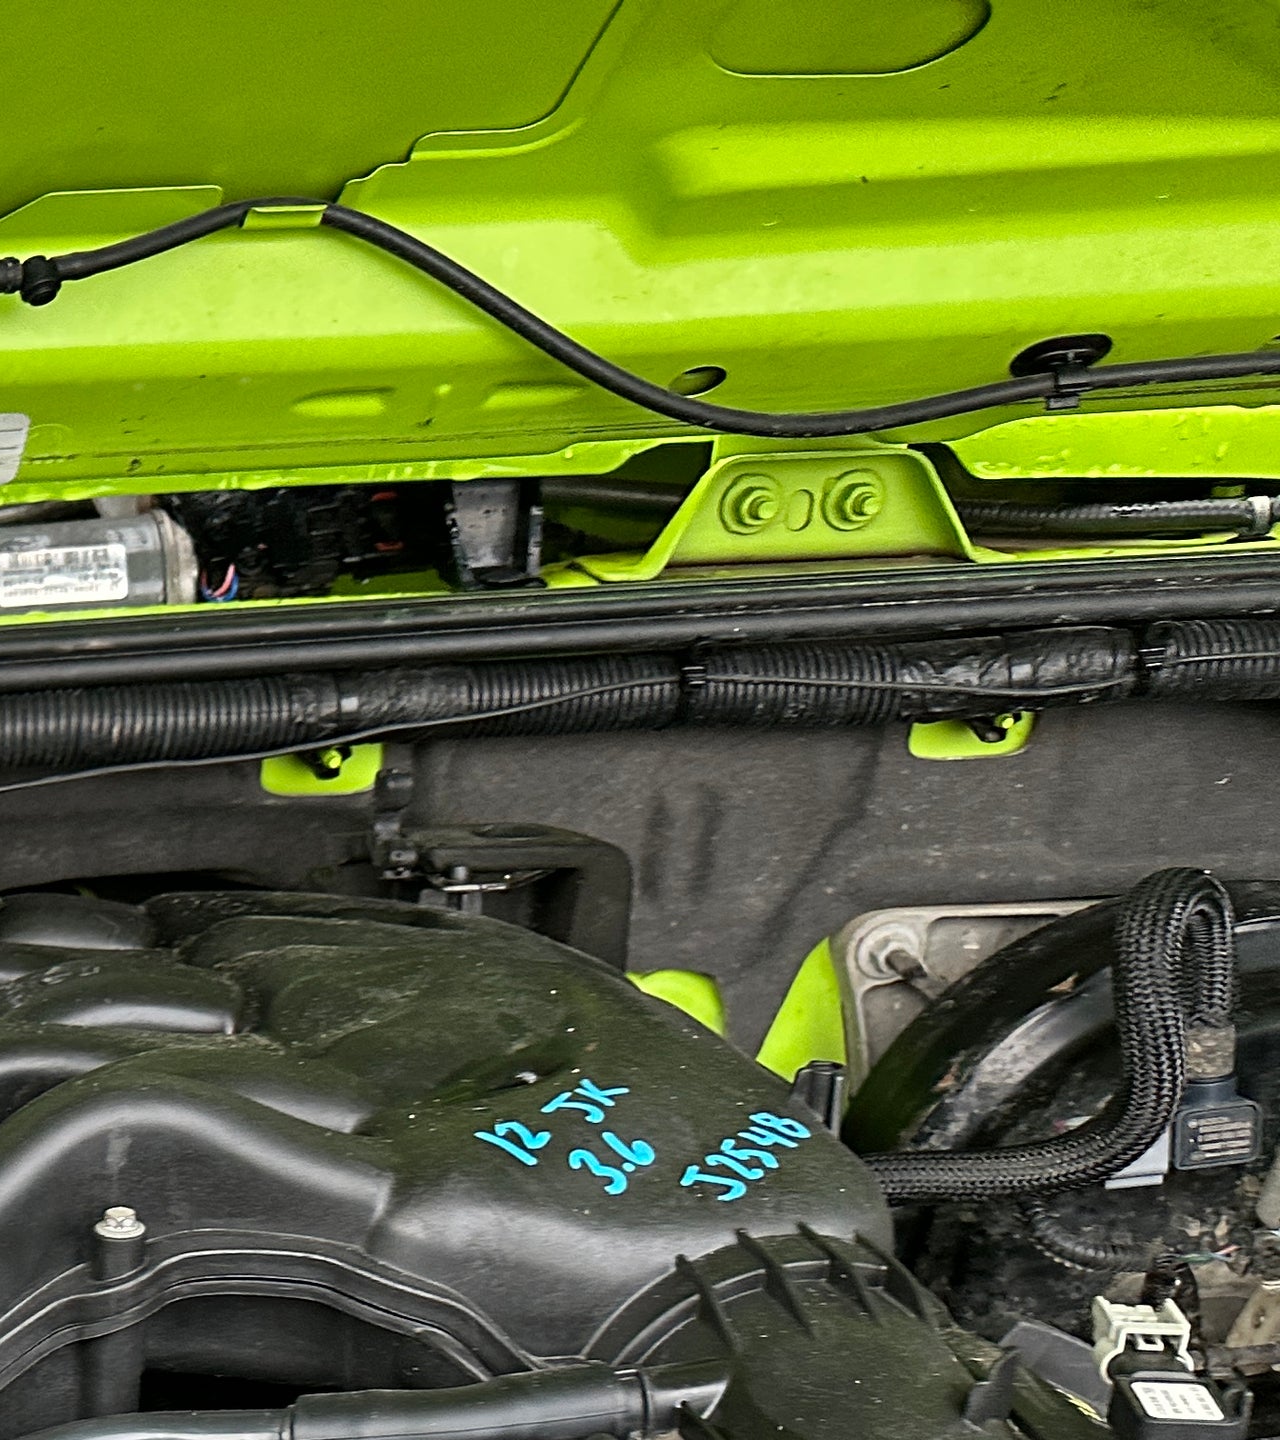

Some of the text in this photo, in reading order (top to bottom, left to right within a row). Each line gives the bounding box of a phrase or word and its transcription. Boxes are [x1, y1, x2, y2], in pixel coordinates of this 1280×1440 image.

[474, 1078, 630, 1167] 12 JK
[568, 1131, 656, 1195] 3.6
[679, 1111, 812, 1201] J2548
